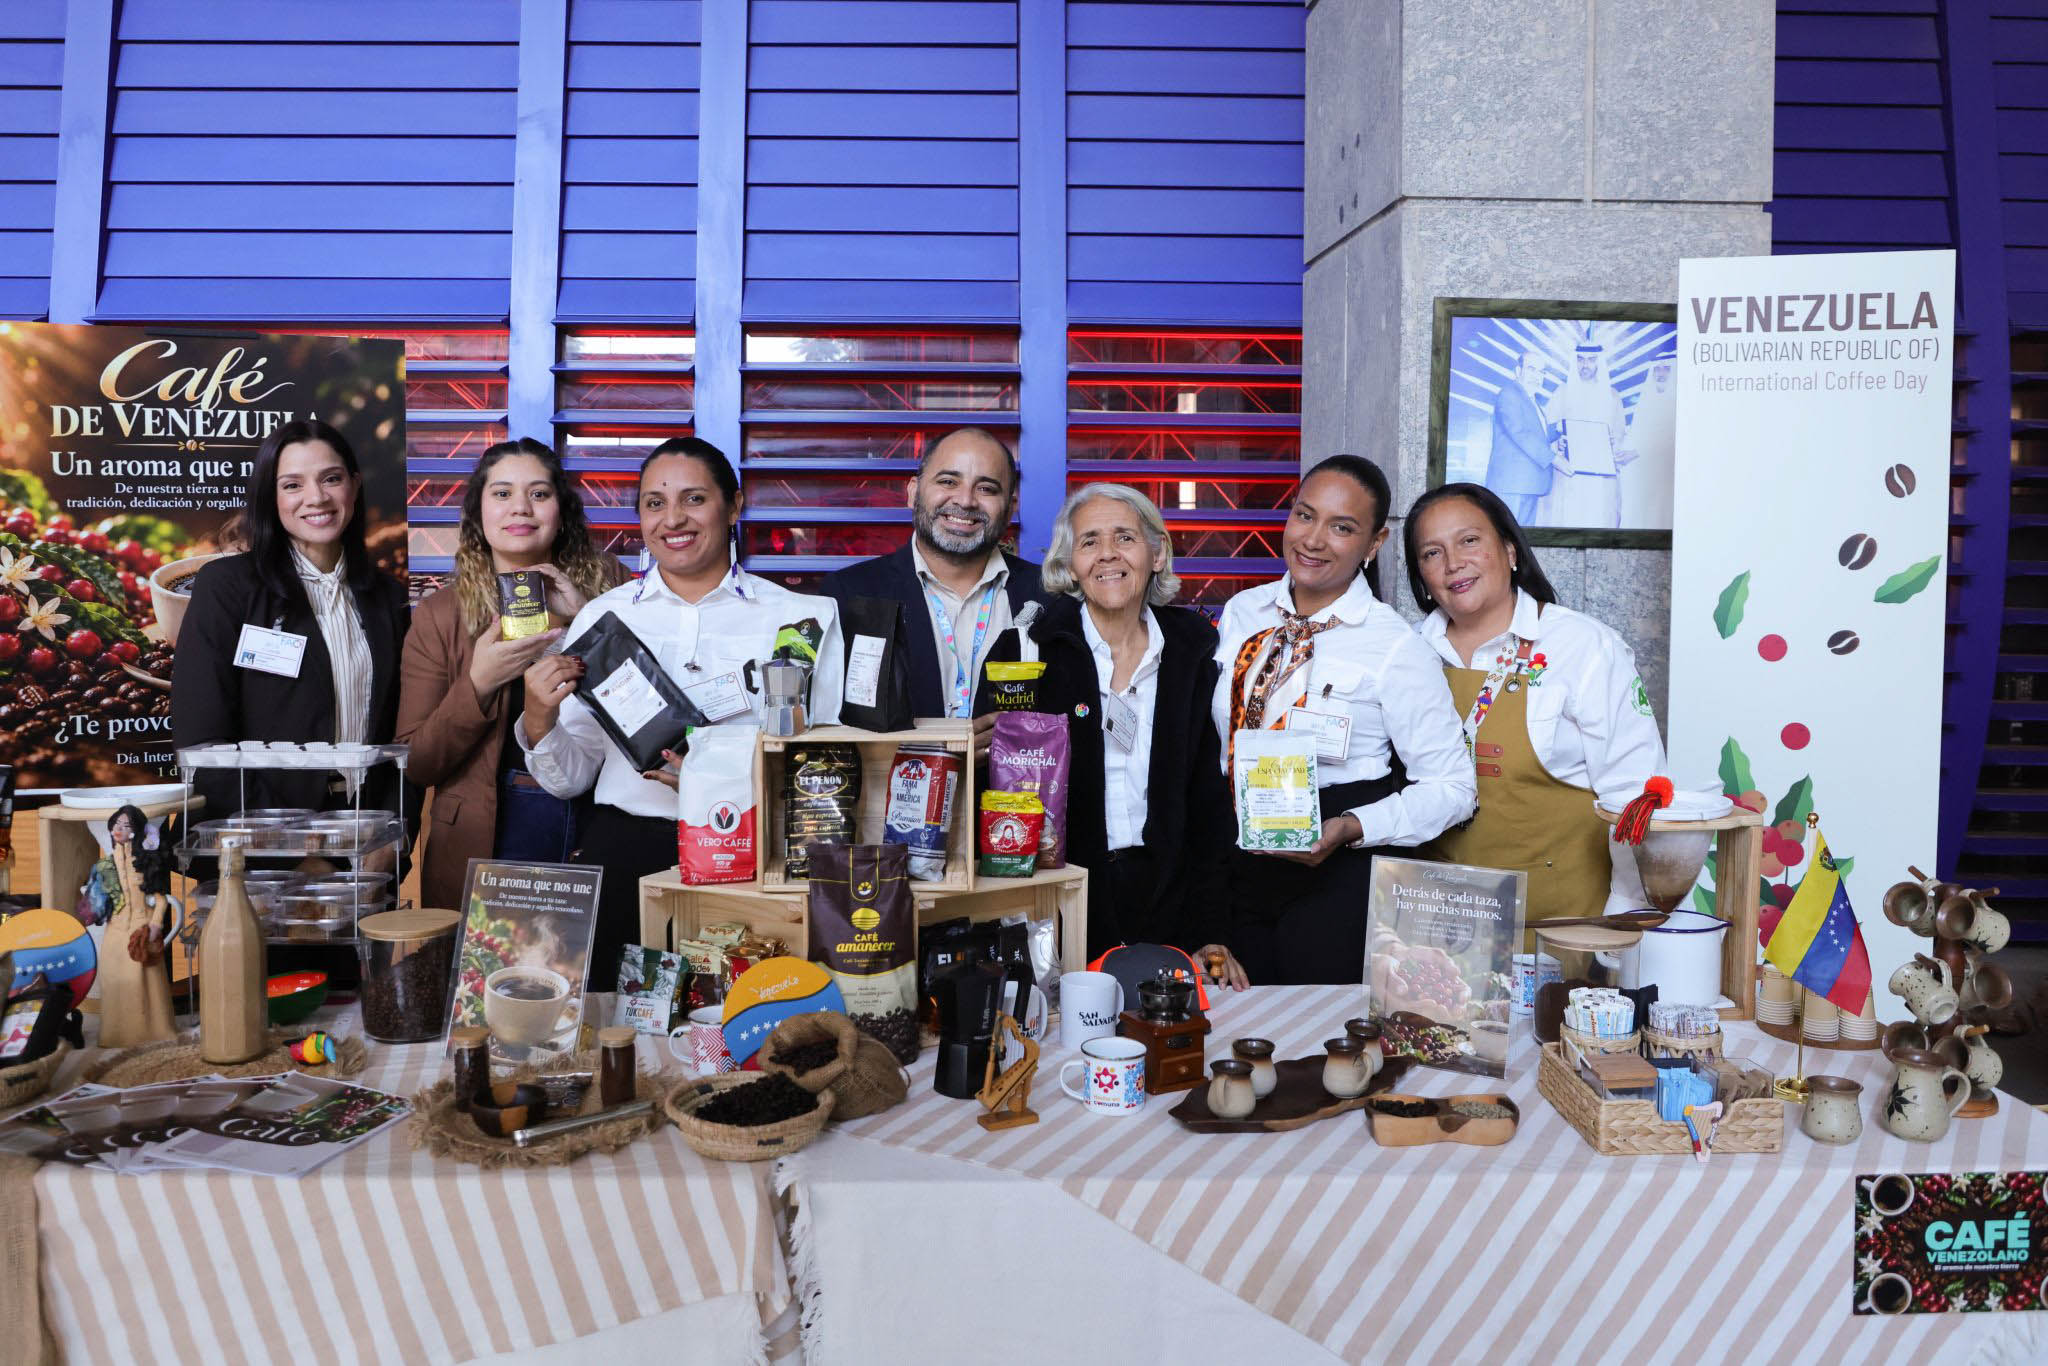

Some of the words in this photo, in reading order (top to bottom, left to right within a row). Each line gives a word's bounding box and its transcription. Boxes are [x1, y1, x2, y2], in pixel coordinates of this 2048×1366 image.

[1691, 291, 1938, 334] VENEZUELA
[1693, 341, 1803, 365] (BOLIVARIAN
[1810, 338, 1902, 362] REPUBLIC
[1908, 337, 1940, 362] OF)
[100, 339, 296, 410] Café
[1701, 371, 1818, 393] International
[1825, 371, 1887, 391] Coffee
[1894, 370, 1929, 394] Day
[50, 405, 104, 438] DE
[109, 402, 319, 439] VENEZUE
[50, 451, 93, 477] Un
[100, 458, 182, 478] aroma
[189, 459, 236, 484] que
[114, 482, 134, 494] De
[137, 484, 183, 495] nuestra
[186, 482, 219, 495] tierra
[222, 486, 229, 495] a
[233, 484, 247, 495] tu
[66, 495, 127, 509] tradición,
[130, 495, 193, 509] dedicación
[196, 499, 204, 512] y
[1003, 682, 1025, 693] Café
[995, 690, 1034, 705] Madrid
[54, 714, 100, 744] ¿Te
[107, 715, 173, 741] provo
[116, 752, 140, 765] Día
[144, 751, 174, 763] Inter
[1019, 746, 1045, 757] CAFÉ
[169, 765, 179, 777] d
[696, 837, 722, 848] VERO
[481, 871, 497, 887] Un
[499, 877, 532, 889] aroma
[533, 880, 552, 894] que
[553, 882, 571, 892] nos
[573, 883, 592, 895] une
[1392, 883, 1430, 899] Detrás
[1431, 888, 1446, 901] de
[1447, 891, 1473, 904] cada
[1475, 895, 1502, 909] taza,
[1396, 897, 1416, 913] hay
[1418, 902, 1460, 916] muchas
[1462, 908, 1503, 921] manos.
[854, 931, 879, 942] CAFÉ
[836, 941, 896, 953] amanecer
[1079, 1011, 1099, 1020] SAN
[1924, 1211, 2031, 1251] CAFÉ
[1926, 1249, 2030, 1263] VENEZOLANO
